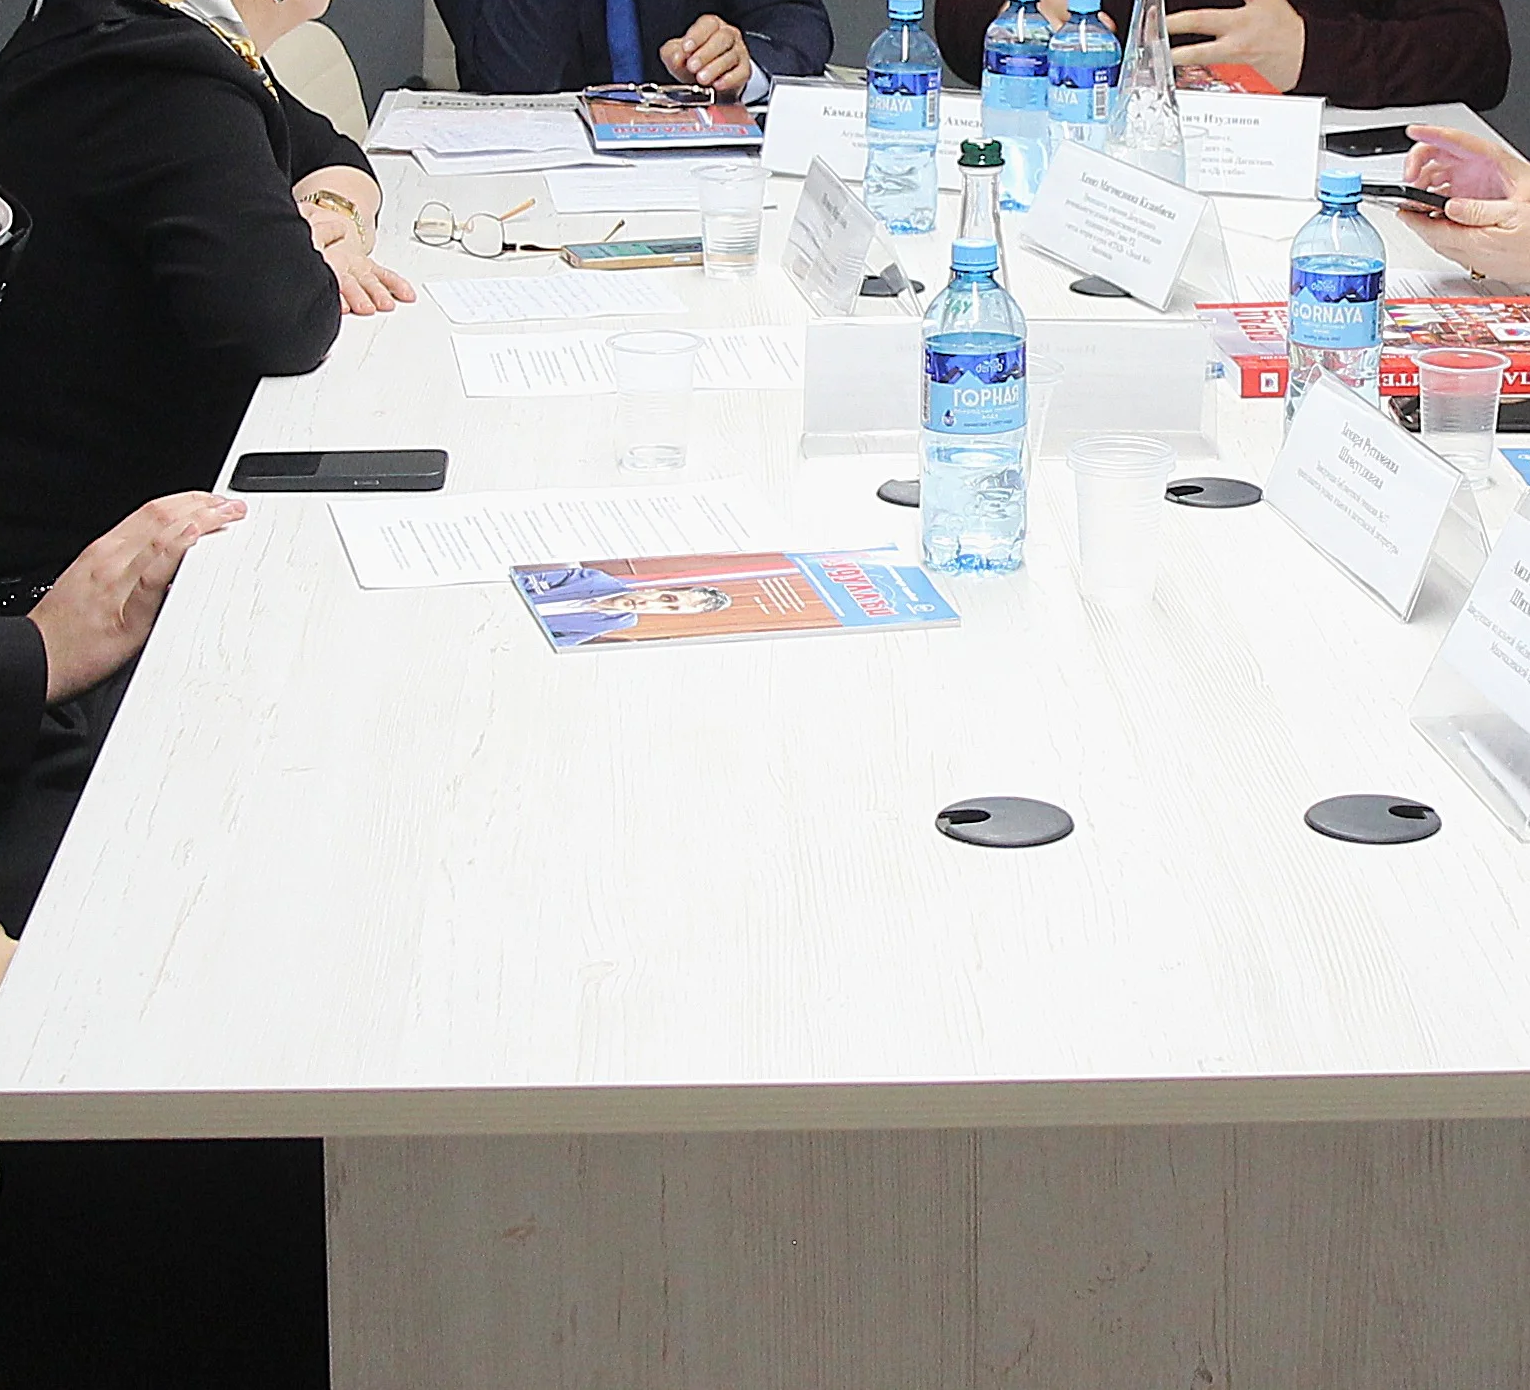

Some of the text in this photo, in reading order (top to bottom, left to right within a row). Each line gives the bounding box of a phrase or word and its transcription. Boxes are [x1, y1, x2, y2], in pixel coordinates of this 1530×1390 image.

[822, 105, 983, 127] Камалд Ахмедо
[1291, 300, 1364, 325] GORNAYA
[953, 384, 1019, 407] ГОРНАЯ
